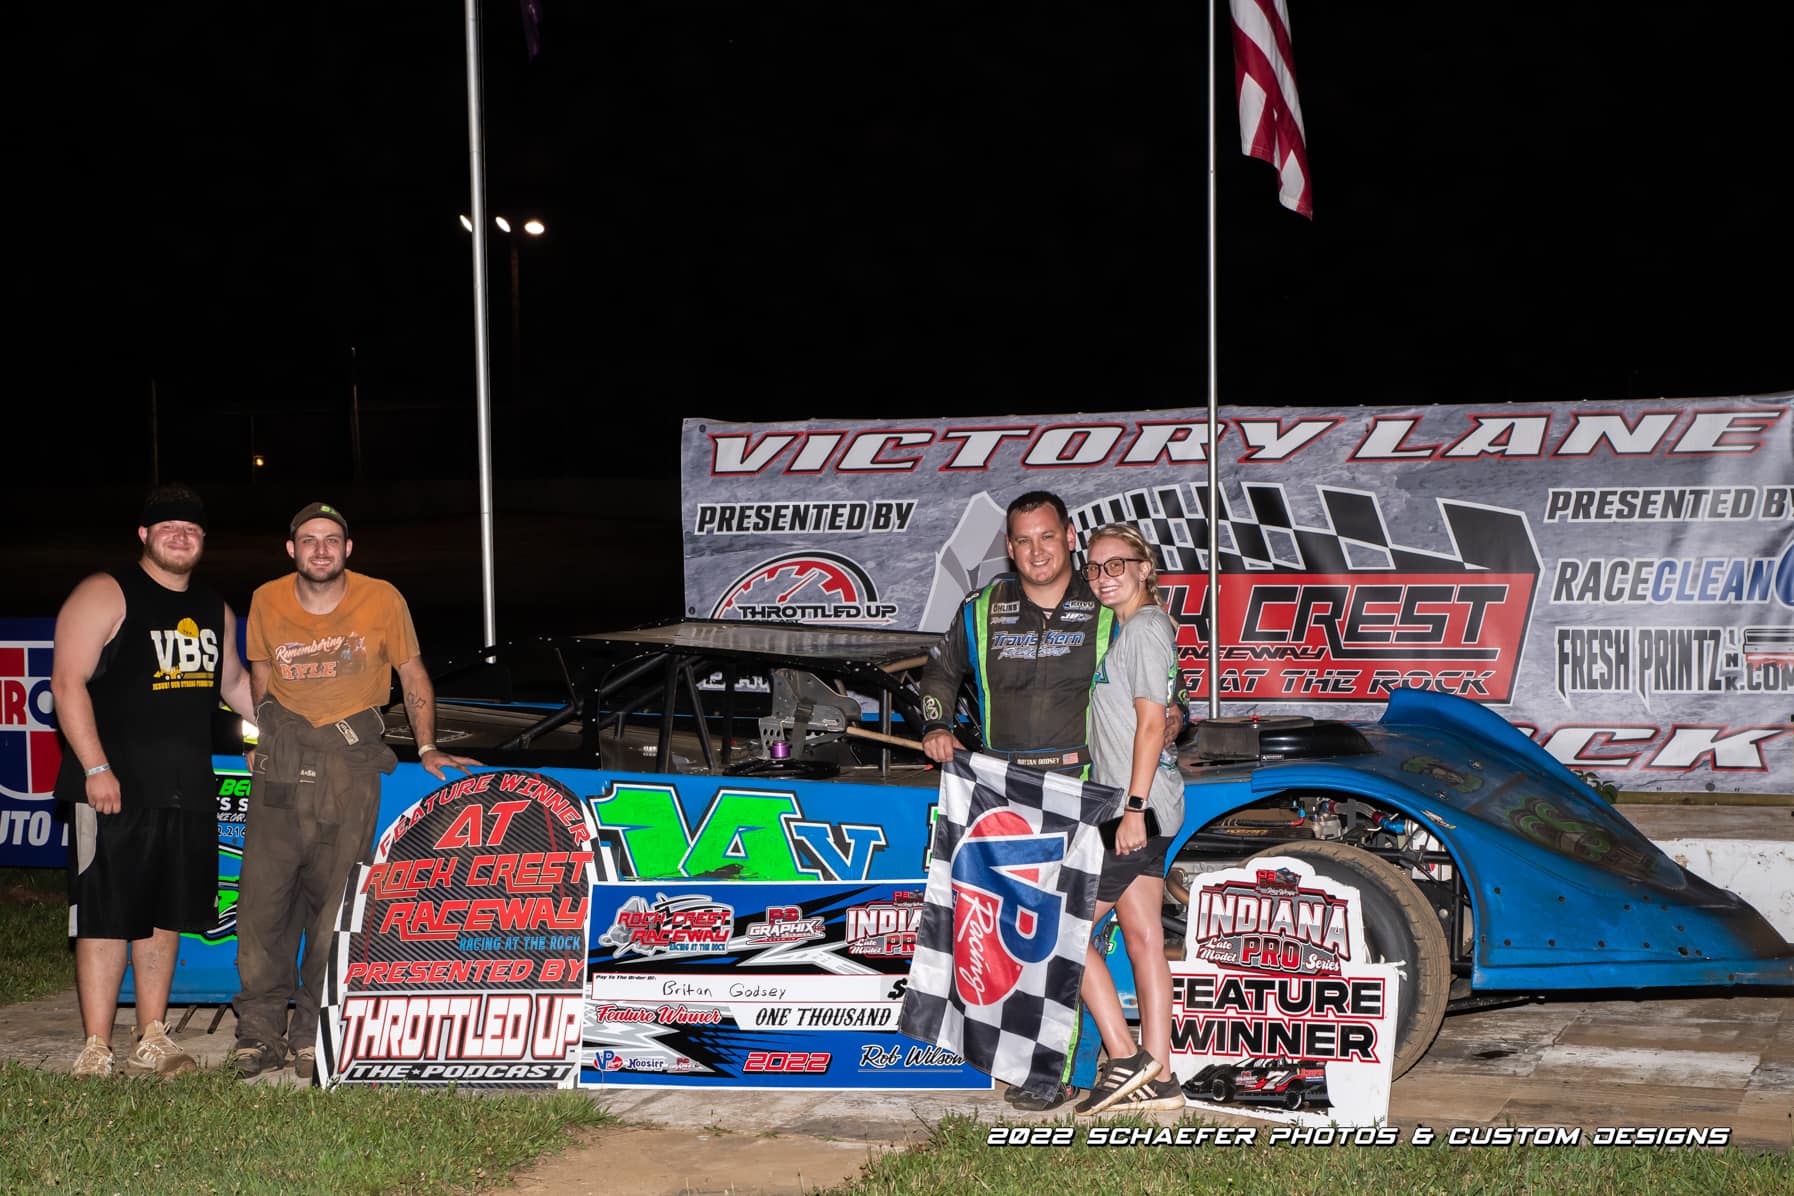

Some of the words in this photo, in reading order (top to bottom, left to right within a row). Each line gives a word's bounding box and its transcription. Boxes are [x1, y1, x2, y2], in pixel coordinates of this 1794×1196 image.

[709, 417, 1346, 476] VICTORY
[1347, 406, 1790, 463] LANE
[1545, 487, 1756, 522] PRESENTED
[696, 502, 864, 535] PRESENTED
[871, 500, 916, 532] BY
[1553, 559, 1776, 603] RACECLEAN
[737, 605, 859, 619] THROTTLED
[866, 605, 897, 619] UP
[1241, 585, 1509, 661] CREST
[150, 628, 219, 672] VBS
[275, 636, 345, 664] Remembering
[991, 631, 1039, 649] Travis
[1042, 629, 1086, 647] Kern
[280, 661, 337, 680] KYLE
[1556, 628, 1631, 701] FRESH
[1637, 628, 1721, 703] PRINTZ
[1220, 669, 1269, 693] AT
[1280, 669, 1361, 693] THE
[1367, 670, 1496, 695] ROCK
[379, 773, 495, 856] FEATURE
[499, 773, 591, 844] WINNER
[434, 800, 531, 849] AT
[361, 857, 458, 899] ROCK
[466, 852, 594, 894] CREST
[379, 897, 590, 941] RACEWAY
[618, 912, 667, 929] ROCK
[671, 912, 731, 928] CREST
[750, 920, 816, 937] GRAPHIX
[846, 908, 922, 943] INDIA
[1196, 890, 1350, 961] INDIANA
[459, 936, 501, 951] RACING
[504, 936, 520, 950] AT
[523, 936, 545, 950] THE
[550, 936, 580, 950] ROCK
[631, 930, 730, 945] RACEWAY
[884, 934, 917, 954] PR
[957, 892, 994, 1006] Racing
[1205, 938, 1233, 950] Late
[1200, 949, 1237, 963] Model
[1241, 935, 1302, 969] PRO
[1305, 954, 1340, 971] Series
[344, 960, 534, 984] PRESENTED
[538, 959, 586, 982] BY
[730, 983, 787, 1000] Godsey
[597, 1004, 655, 1023] Feature
[657, 1004, 721, 1024] Winner
[755, 1008, 792, 1026] ONE
[797, 1008, 892, 1026] THOUSAND
[340, 995, 536, 1073] THROTTLED
[534, 994, 583, 1059] UP
[1170, 1019, 1378, 1059] WINNER
[627, 1058, 664, 1069] Hoosier
[743, 1052, 831, 1072] 2022
[860, 1045, 901, 1067] Rob
[904, 1045, 965, 1068] Wilson
[352, 1064, 411, 1079] THE
[420, 1063, 573, 1079] PODCAST
